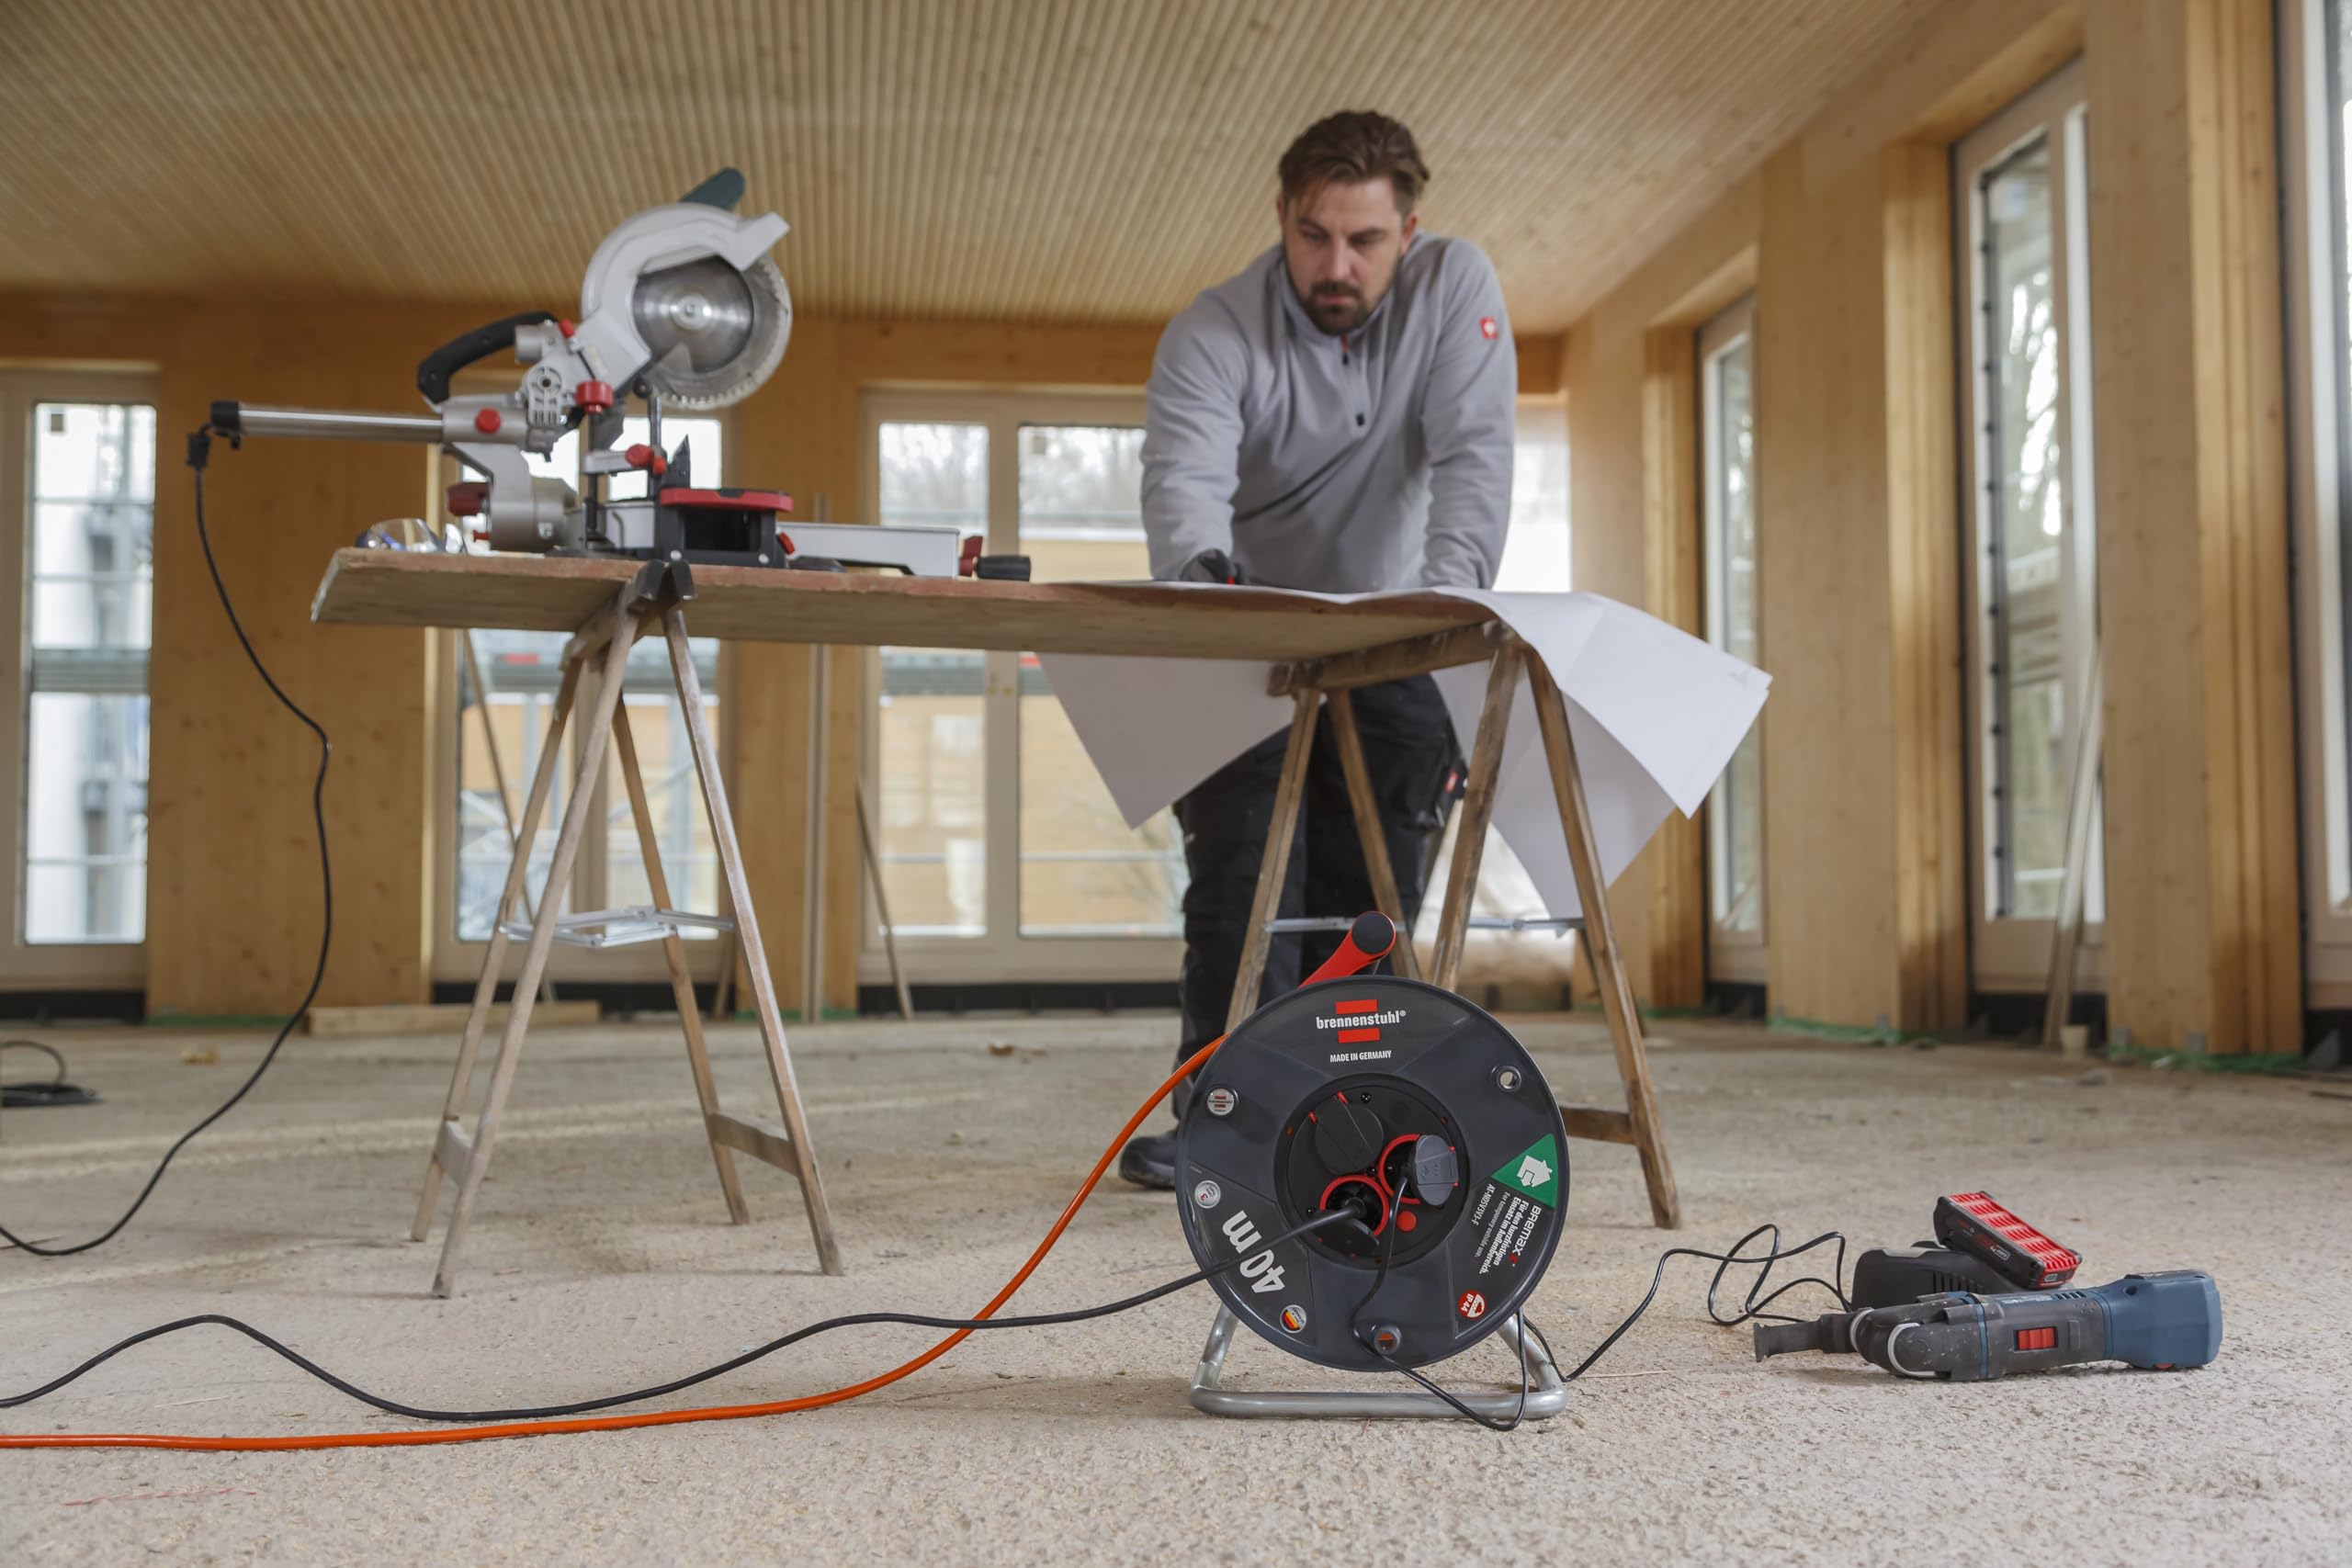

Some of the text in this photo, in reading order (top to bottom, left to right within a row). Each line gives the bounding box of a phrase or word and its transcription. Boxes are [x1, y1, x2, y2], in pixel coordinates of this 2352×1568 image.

[1329, 1050, 1392, 1063] MADE IN GERMANY
[1488, 1201, 1505, 1228] temporary
[1479, 1197, 1521, 1274] Einsatz im Außenbereich.
[1480, 1228, 1492, 1247] outside
[1490, 1200, 1529, 1265] Für den kurzfristigen
[1222, 1210, 1285, 1293] 40 m
[1475, 1247, 1483, 1257] use.
